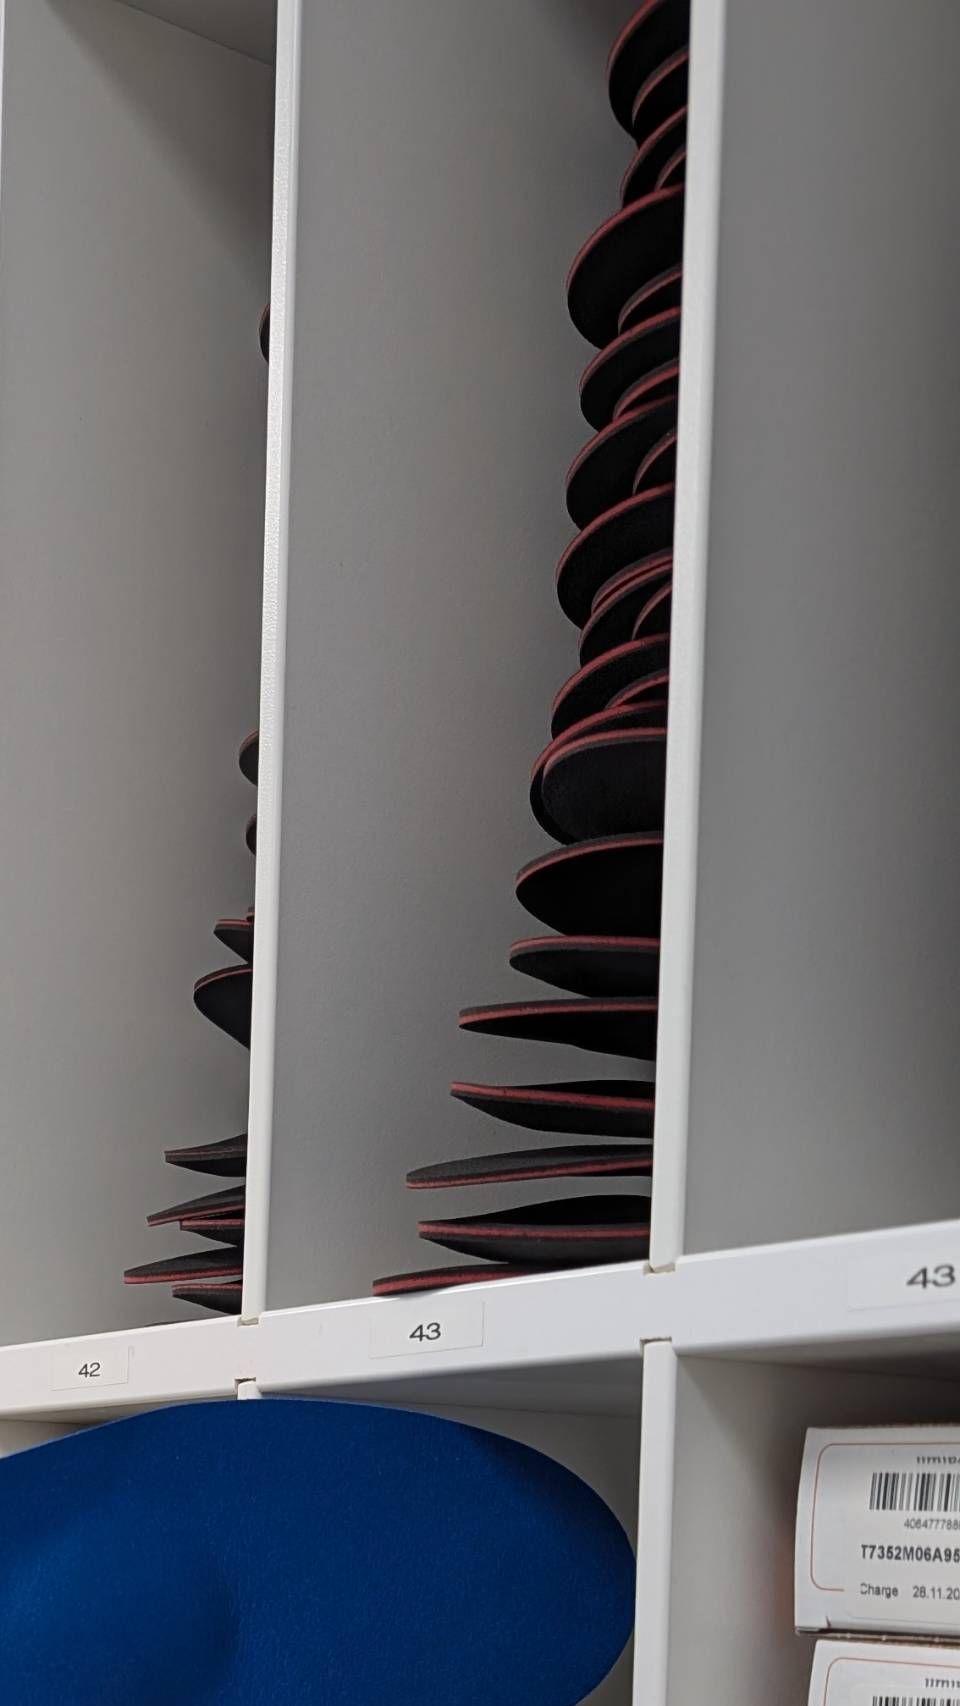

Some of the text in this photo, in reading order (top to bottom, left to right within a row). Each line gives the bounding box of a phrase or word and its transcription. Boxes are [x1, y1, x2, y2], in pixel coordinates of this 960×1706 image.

[906, 1265, 957, 1290] 43
[409, 1322, 441, 1341] 43
[78, 1362, 101, 1378] 42
[904, 1517, 960, 1531] 406477788
[860, 1583, 899, 1599] Charge
